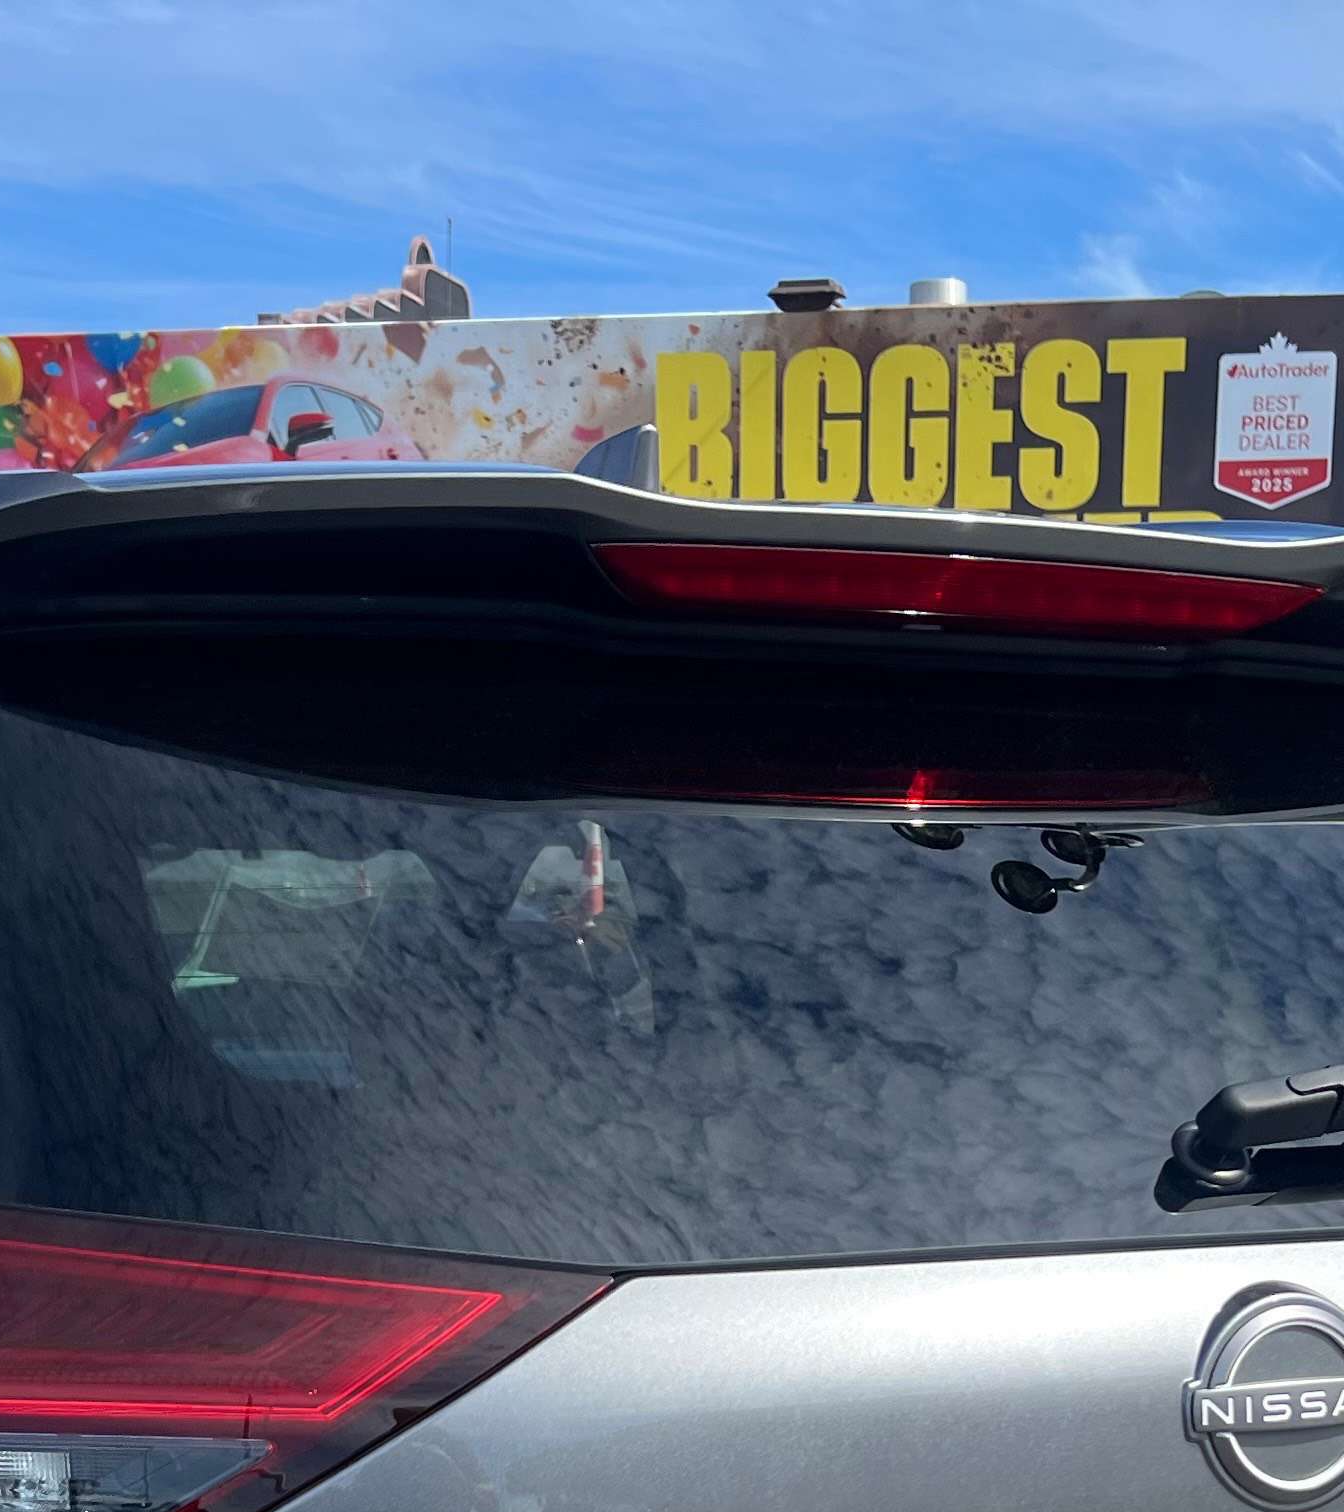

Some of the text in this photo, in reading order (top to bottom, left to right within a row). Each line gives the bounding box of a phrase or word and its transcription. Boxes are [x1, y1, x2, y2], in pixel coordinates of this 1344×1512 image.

[1236, 362, 1329, 379] AutoTrader
[1253, 396, 1298, 412] BEST
[656, 336, 1187, 511] BIGGEST
[1241, 416, 1309, 432] PRICED
[1239, 434, 1310, 450] DEALER
[1251, 477, 1293, 492] 2025
